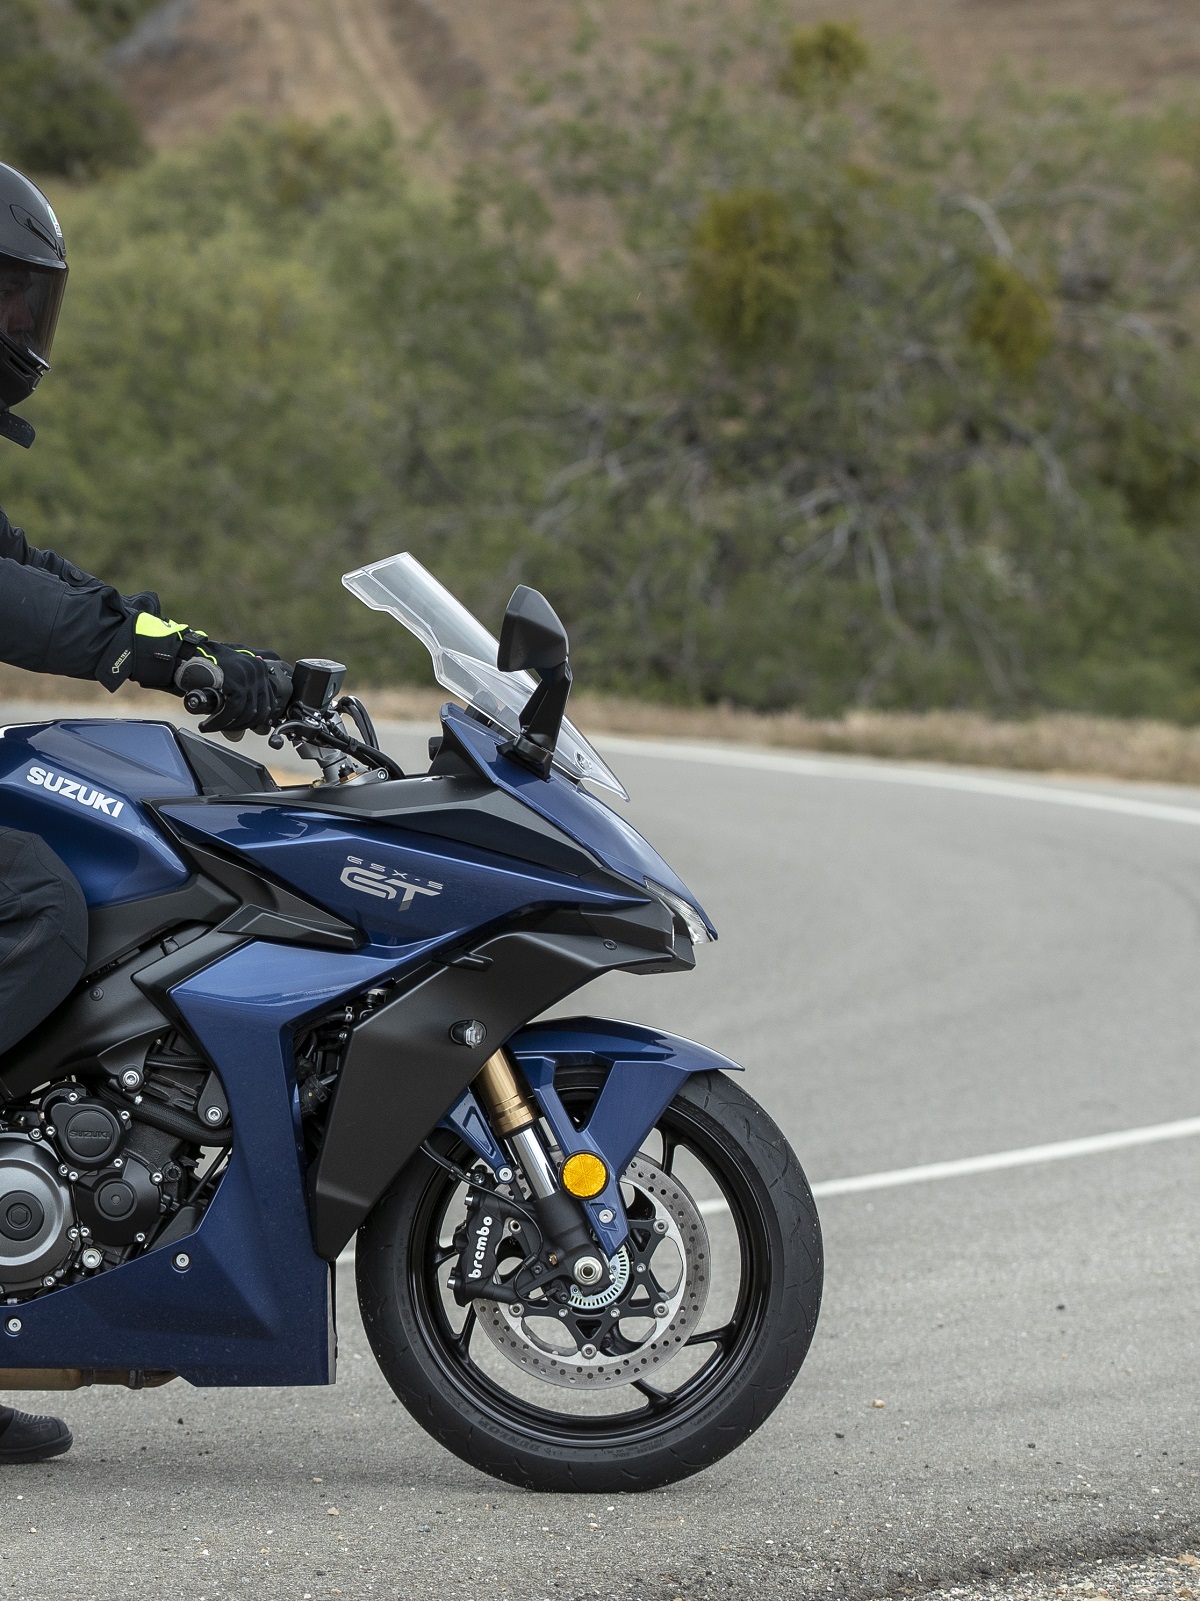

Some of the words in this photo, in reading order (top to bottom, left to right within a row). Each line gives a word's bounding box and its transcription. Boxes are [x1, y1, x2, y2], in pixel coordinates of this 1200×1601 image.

[26, 766, 125, 819] SUZUKI
[339, 866, 441, 912] GT
[347, 855, 444, 891] GSX-S
[68, 1130, 110, 1140] SUZUKI
[467, 1216, 493, 1279] brembo
